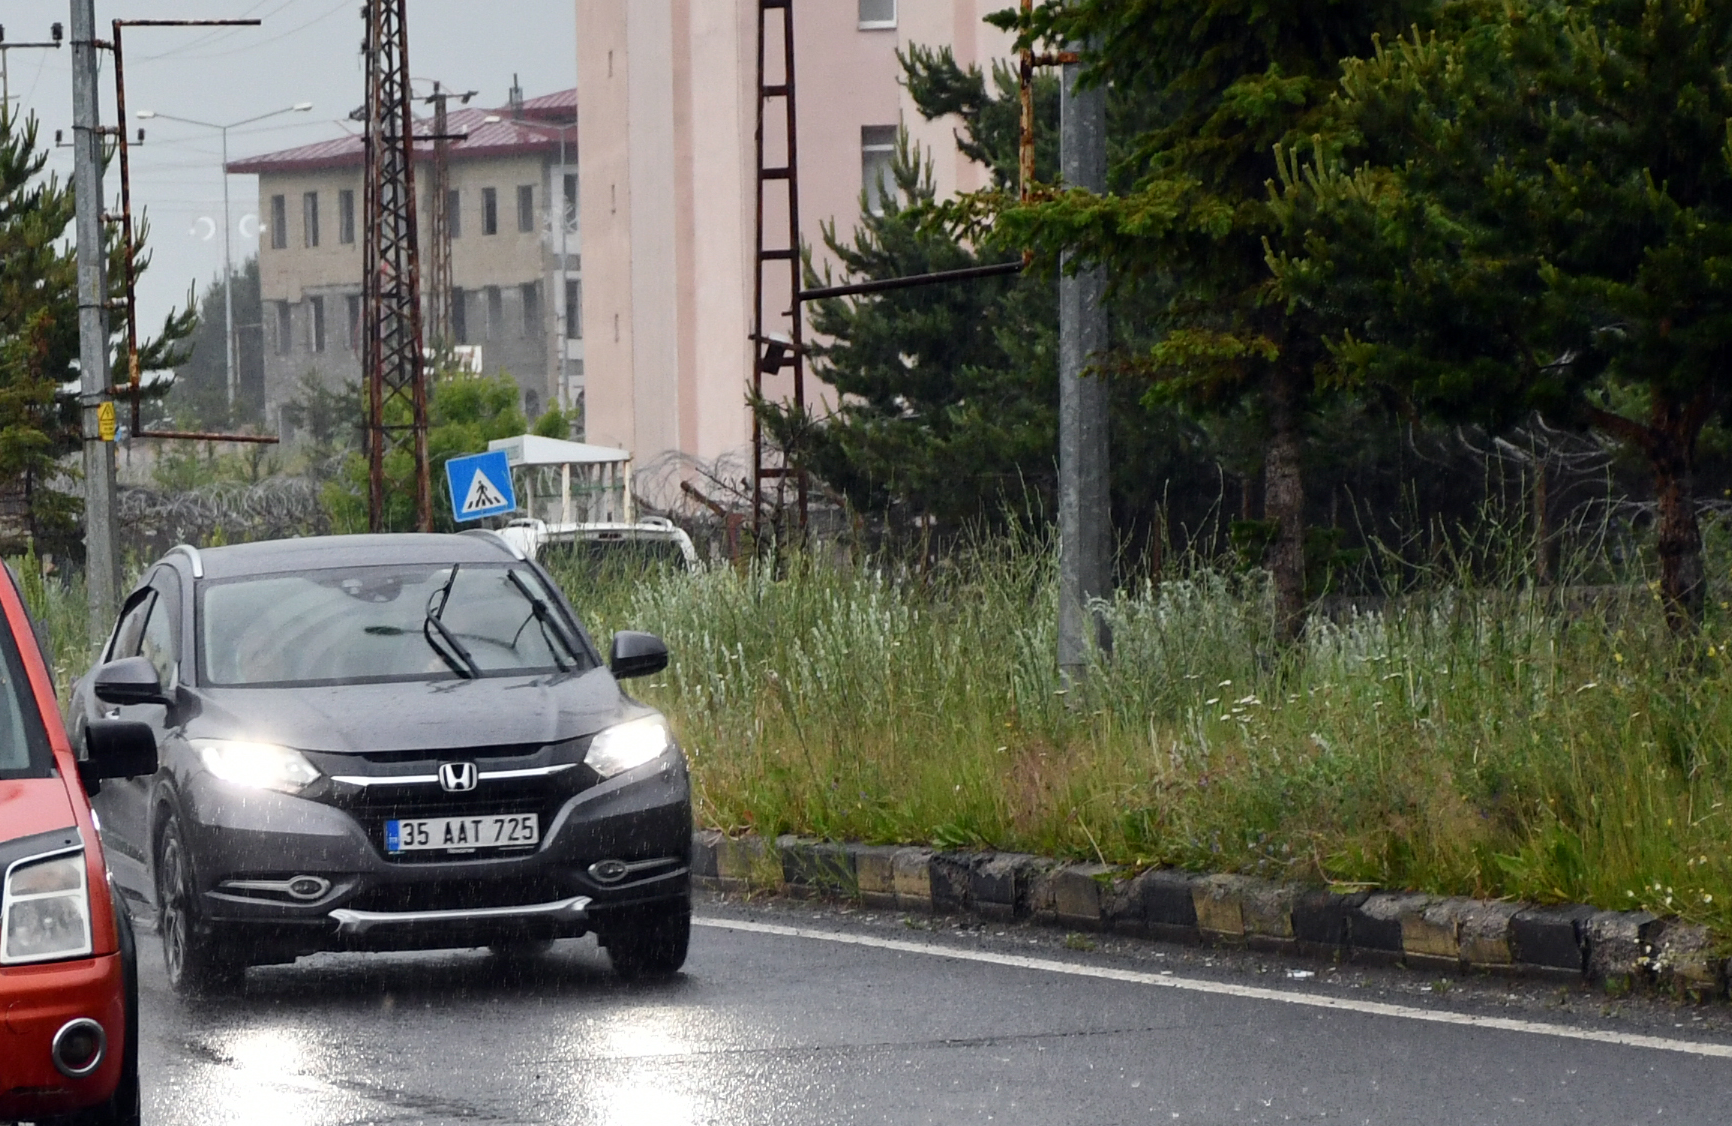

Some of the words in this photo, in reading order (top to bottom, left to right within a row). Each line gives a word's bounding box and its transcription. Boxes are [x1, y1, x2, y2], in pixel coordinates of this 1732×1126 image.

[402, 822, 429, 846] 35
[442, 819, 483, 845] AAT
[493, 817, 534, 843] 725
